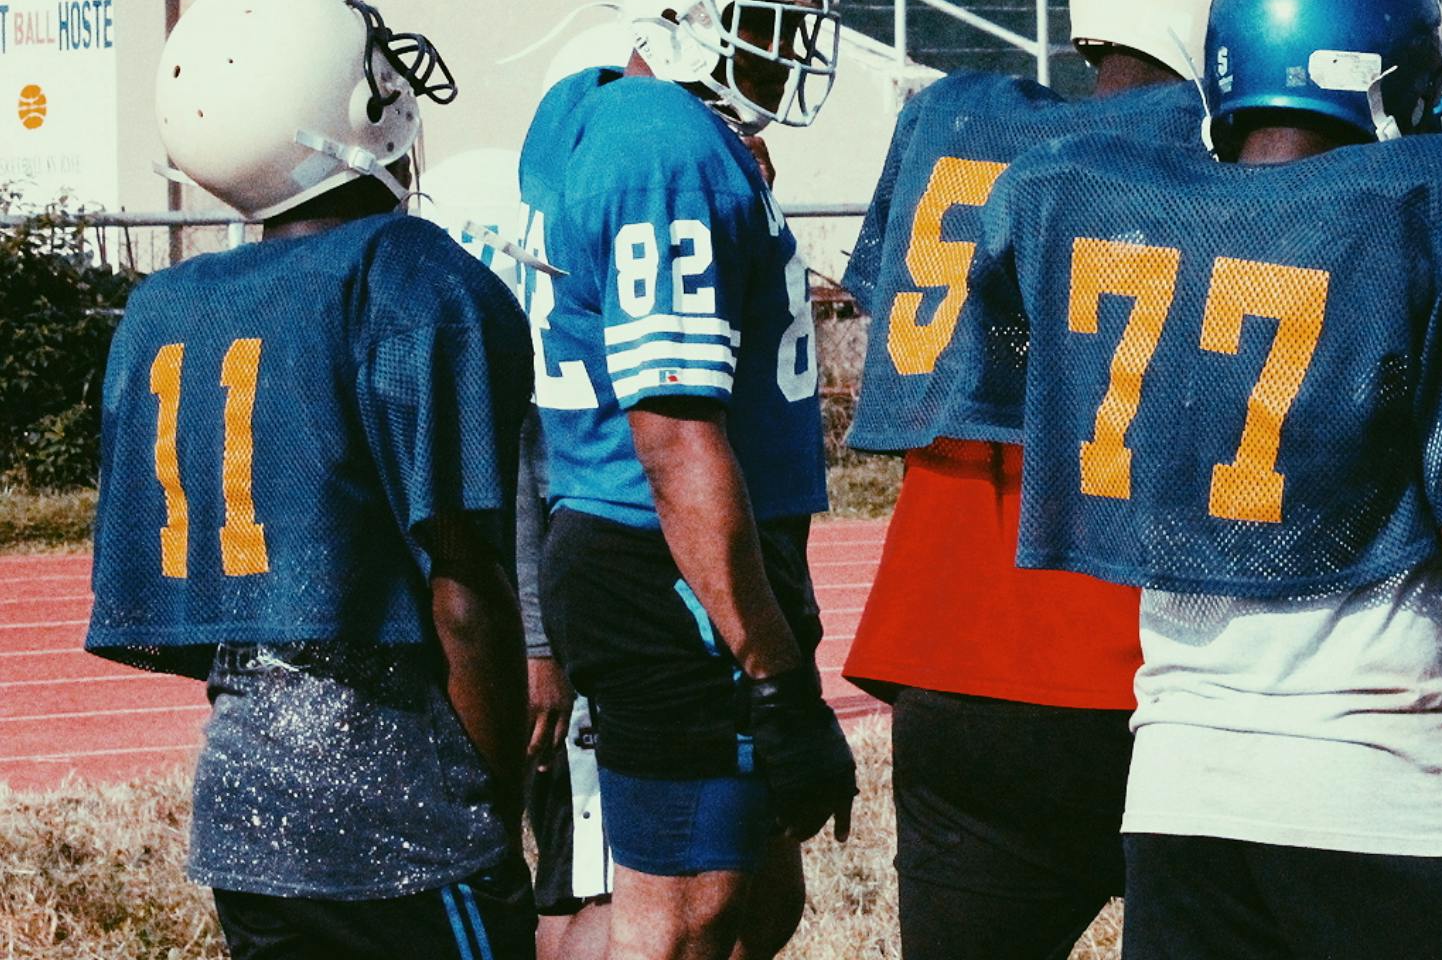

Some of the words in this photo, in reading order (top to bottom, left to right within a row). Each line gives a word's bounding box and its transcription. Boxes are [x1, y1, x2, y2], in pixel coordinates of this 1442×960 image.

[14, 11, 55, 46] BALL
[58, 0, 113, 51] HOSTE
[615, 219, 716, 318] 82
[150, 338, 270, 579] 11
[1067, 236, 1331, 524] 77
